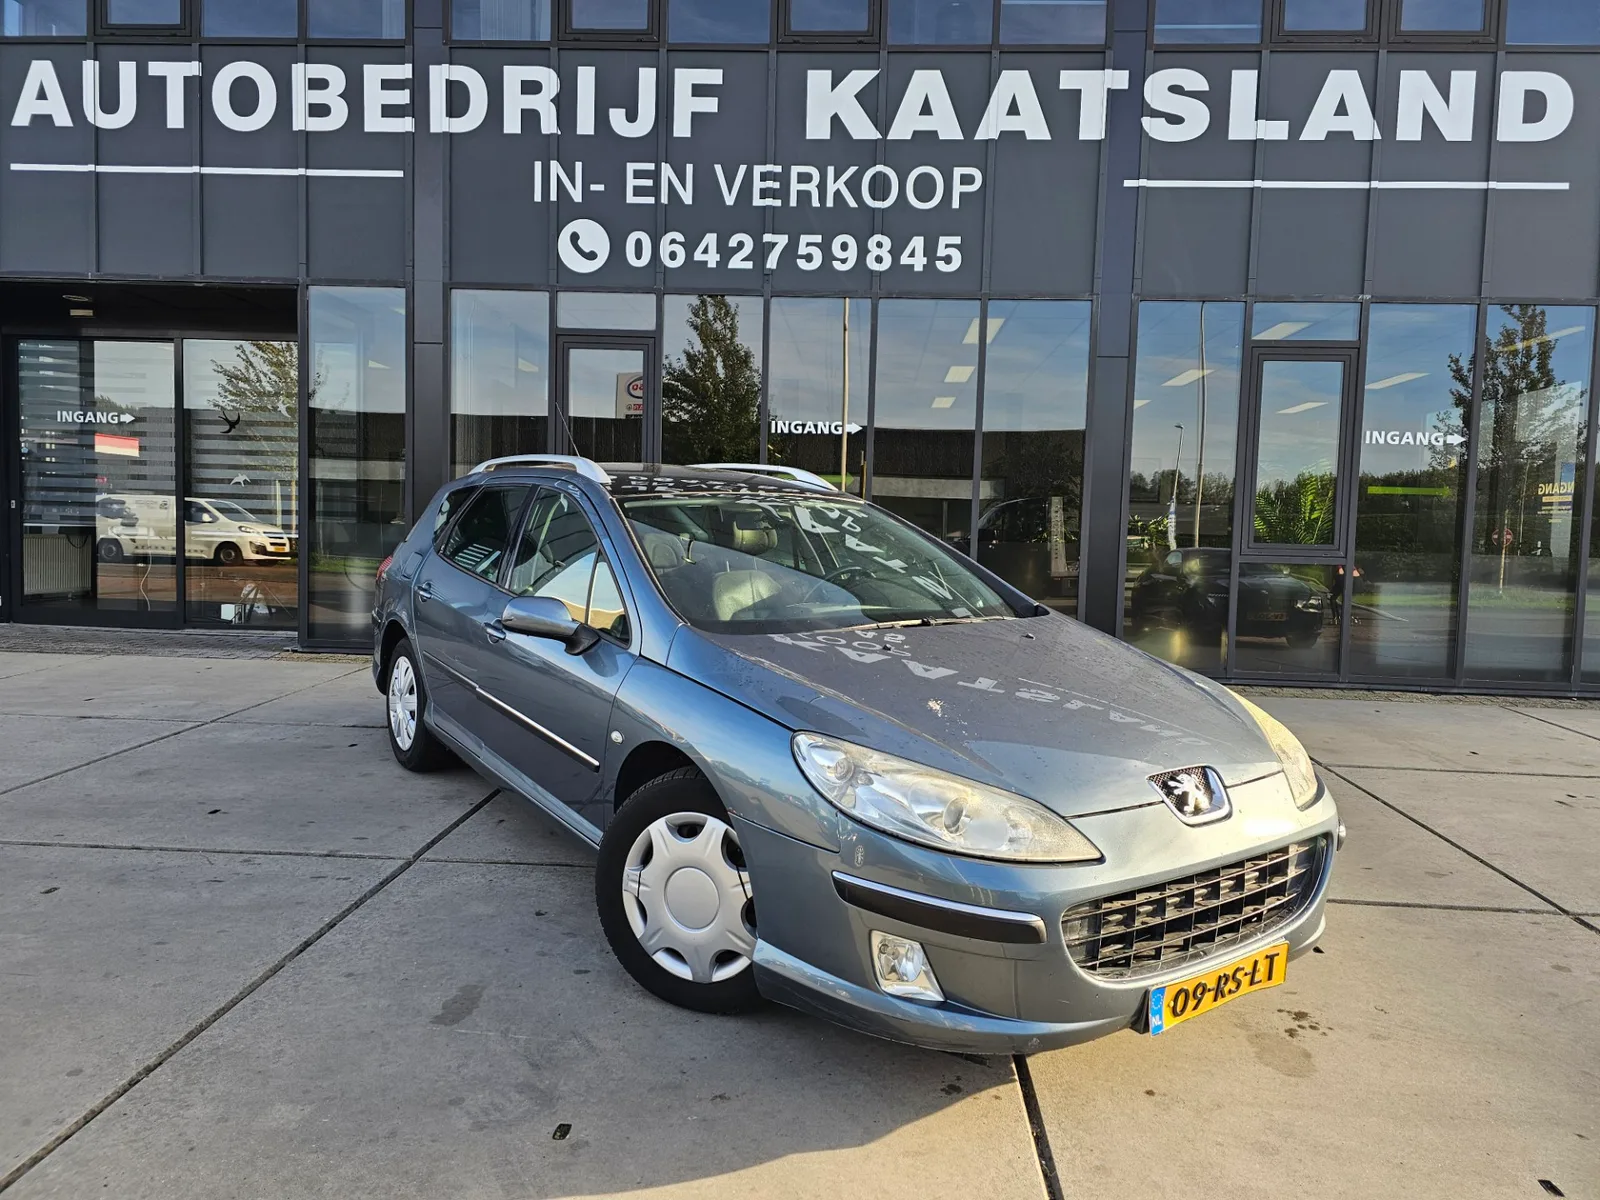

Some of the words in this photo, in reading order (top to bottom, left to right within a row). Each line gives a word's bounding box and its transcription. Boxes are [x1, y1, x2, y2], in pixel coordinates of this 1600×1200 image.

[10, 59, 724, 138] AUTOBEDRIJF
[805, 67, 1575, 143] KAATSLAND
[534, 160, 605, 203] IN-
[626, 162, 694, 205] EN
[713, 164, 983, 210] VERKOOP
[625, 230, 962, 272] 0642759845
[56, 410, 118, 424] INGANG
[771, 420, 843, 434] INGANG
[1365, 430, 1444, 446] INGANG
[1171, 952, 1280, 1018] 09-RS-LT
[1151, 1014, 1162, 1027] NL
